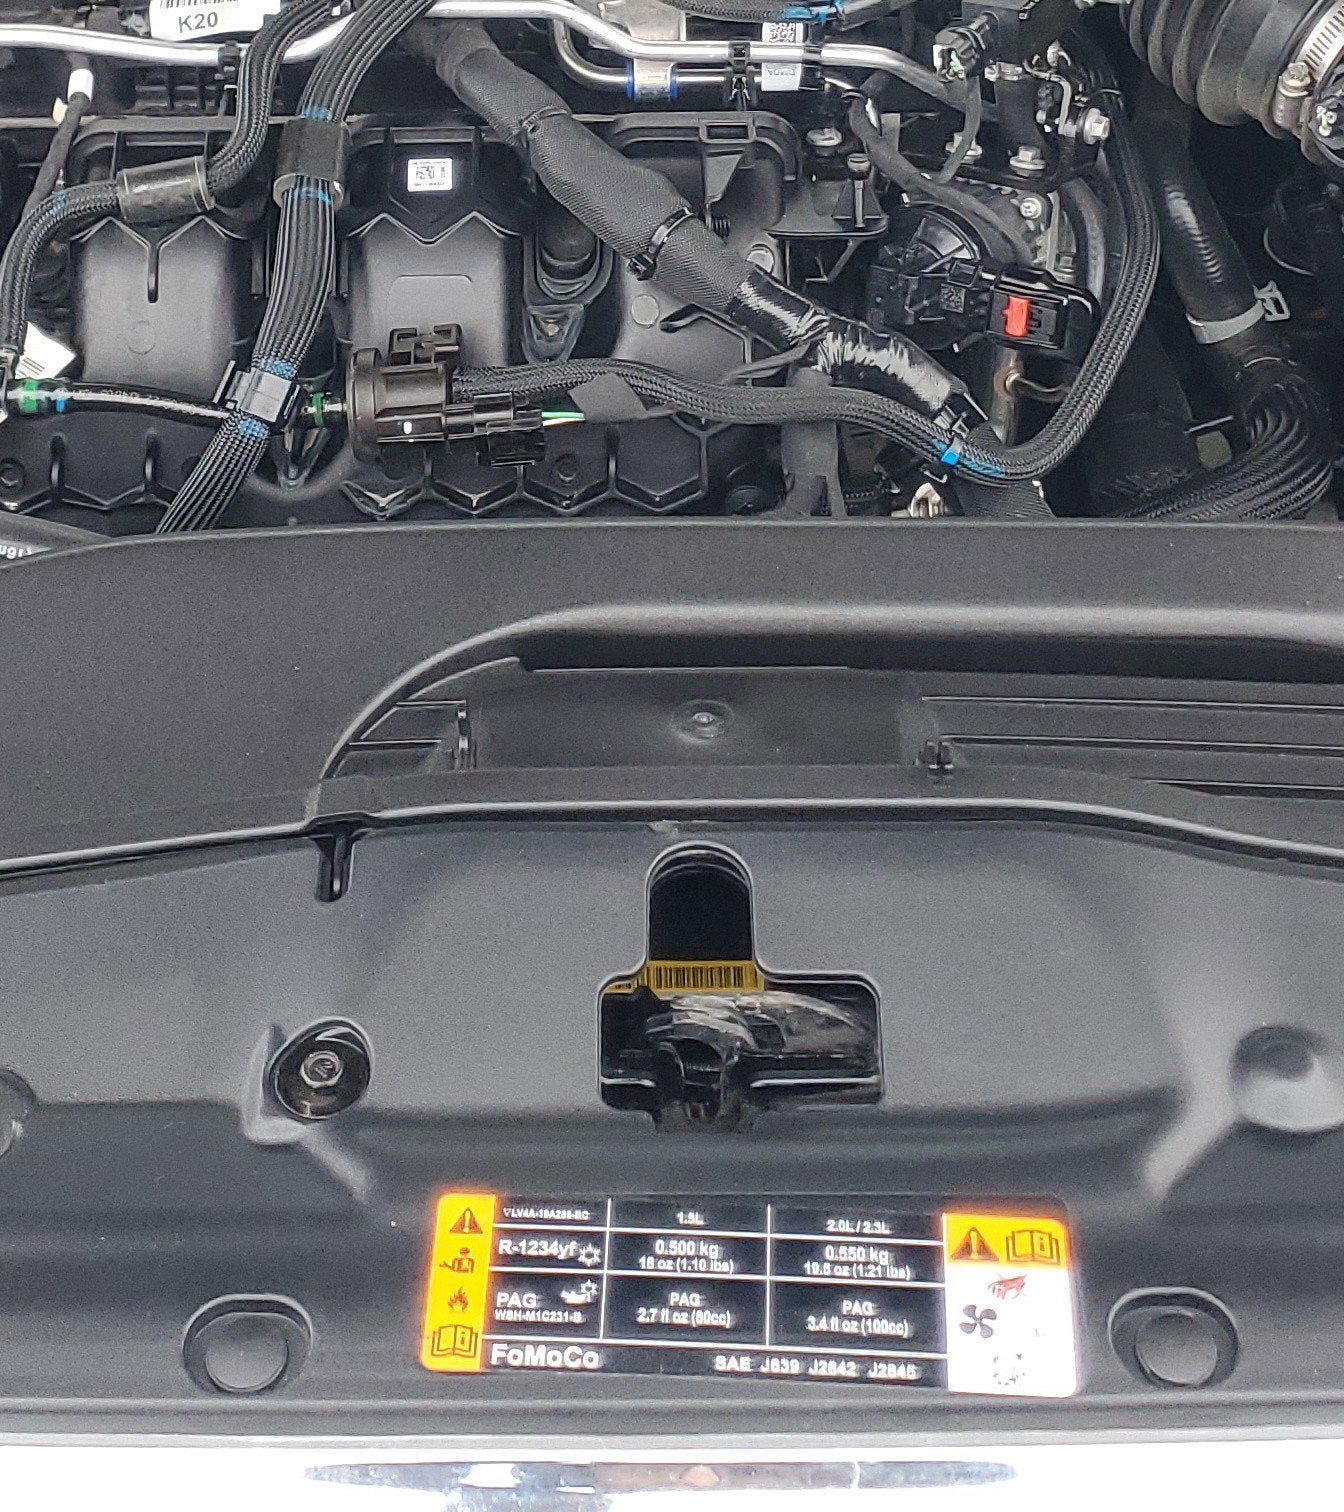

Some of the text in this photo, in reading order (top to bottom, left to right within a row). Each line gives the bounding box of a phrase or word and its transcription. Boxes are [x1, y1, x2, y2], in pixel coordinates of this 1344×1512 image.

[178, 12, 218, 33] K20
[677, 1212, 704, 1226] 1.5L
[826, 1220, 854, 1233] 2.0L
[499, 1239, 577, 1260] R-1234yf
[655, 1239, 720, 1259] 0.500 kg
[825, 1245, 889, 1266] 0.550 kg
[657, 1259, 674, 1271] oz
[677, 1257, 707, 1273] (1.10
[710, 1258, 734, 1274] lbs)
[833, 1265, 850, 1277] oz
[853, 1263, 882, 1278] (1.21
[496, 1292, 537, 1308] PAG
[670, 1292, 701, 1306] PAG
[843, 1300, 873, 1315] PAG
[637, 1307, 658, 1323] 2.7
[660, 1308, 670, 1323] fl
[672, 1311, 688, 1323] oz
[807, 1316, 908, 1337] 3.4 fl oz (100cc)
[491, 1343, 599, 1368] FoMoCo
[714, 1355, 752, 1372] SAE
[760, 1357, 800, 1375] J639
